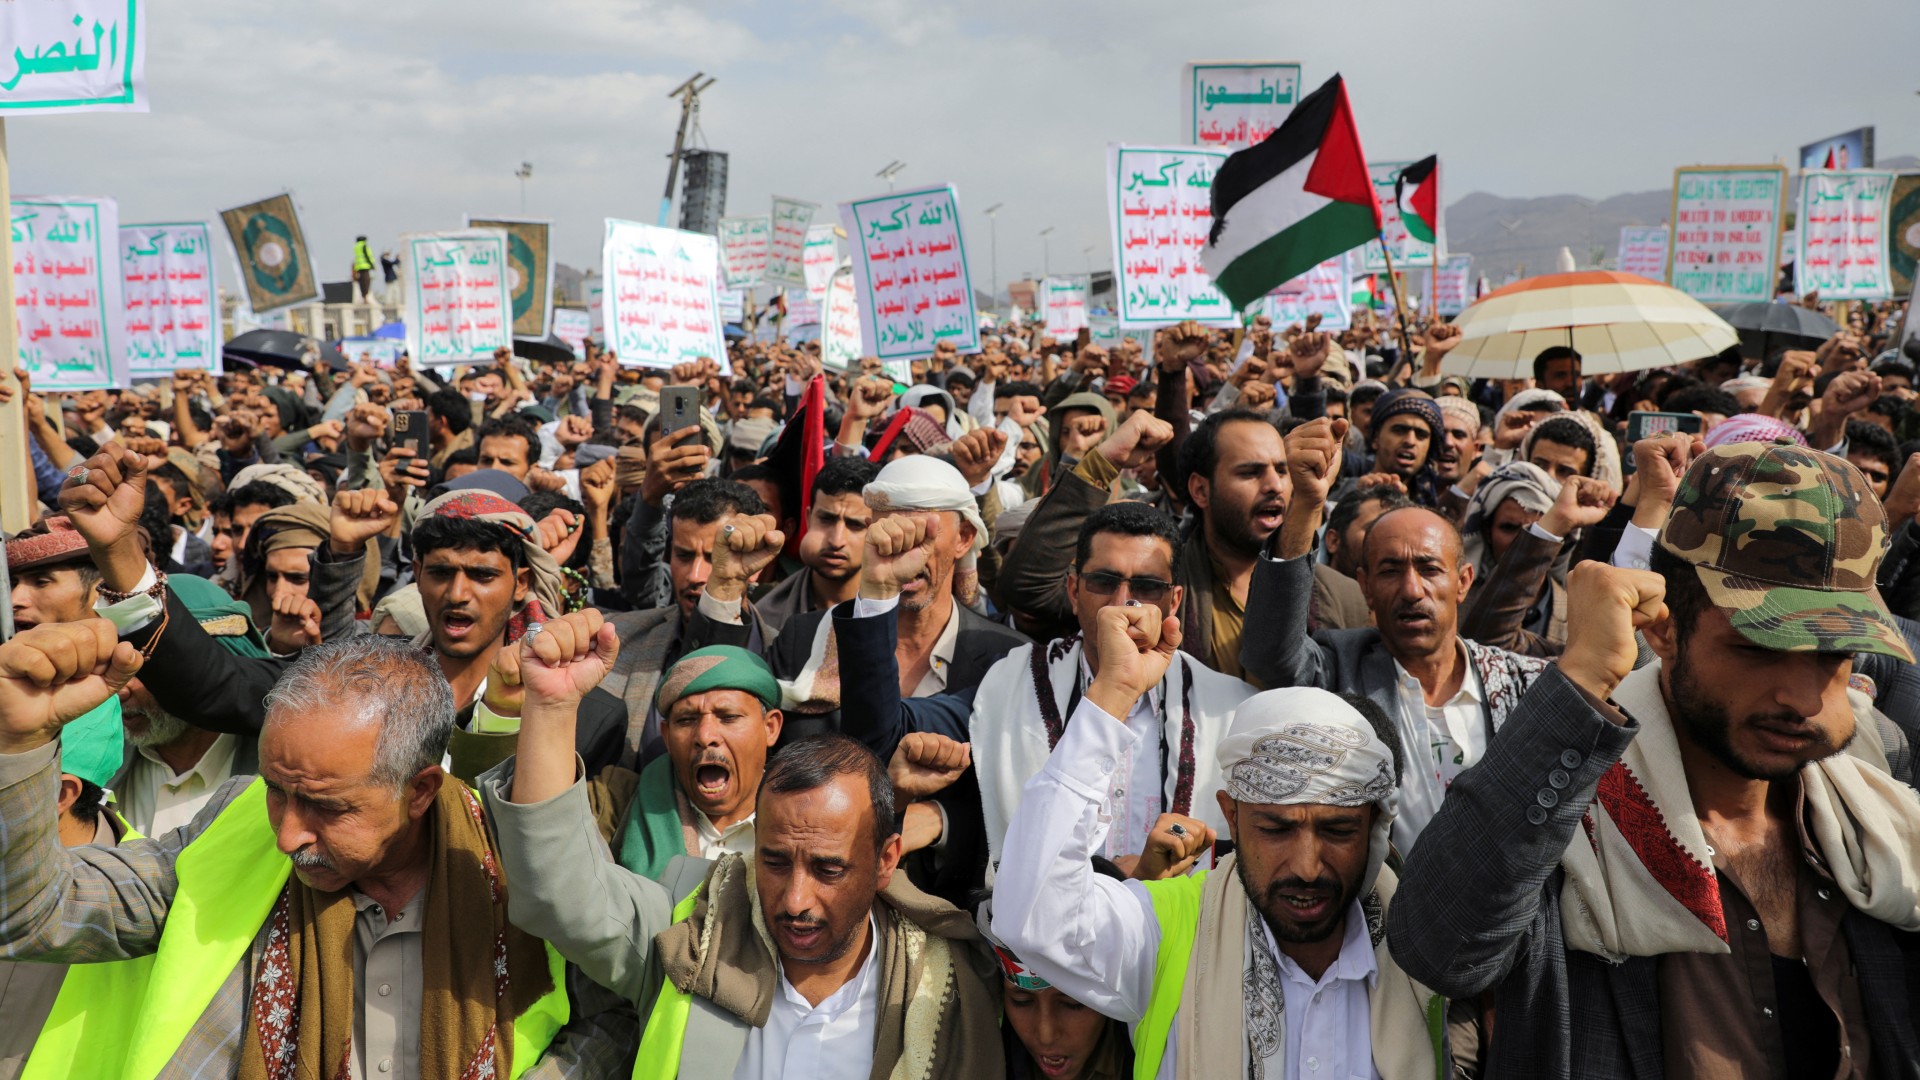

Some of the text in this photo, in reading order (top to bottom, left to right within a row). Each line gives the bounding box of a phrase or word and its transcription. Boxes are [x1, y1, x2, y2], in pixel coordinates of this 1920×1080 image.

[0, 13, 117, 91] النصر
[1200, 78, 1293, 111] قاطعوا
[1125, 157, 1183, 195] أكبر
[47, 212, 91, 243] الله
[866, 199, 952, 241] الله أكبر
[1679, 209, 1772, 223] DEATH TO AMERICA
[125, 229, 204, 263] الله أكبر
[1677, 230, 1761, 243] DEATH TO ISRAEL
[41, 256, 94, 280] الموت
[421, 245, 497, 273] الله أكبر
[1675, 250, 1763, 264] CURSE ON JEWS
[1716, 272, 1734, 293] FOR
[44, 289, 97, 312] الموت
[29, 319, 53, 342] على
[931, 312, 969, 345] النصر
[49, 346, 104, 379] النصر
